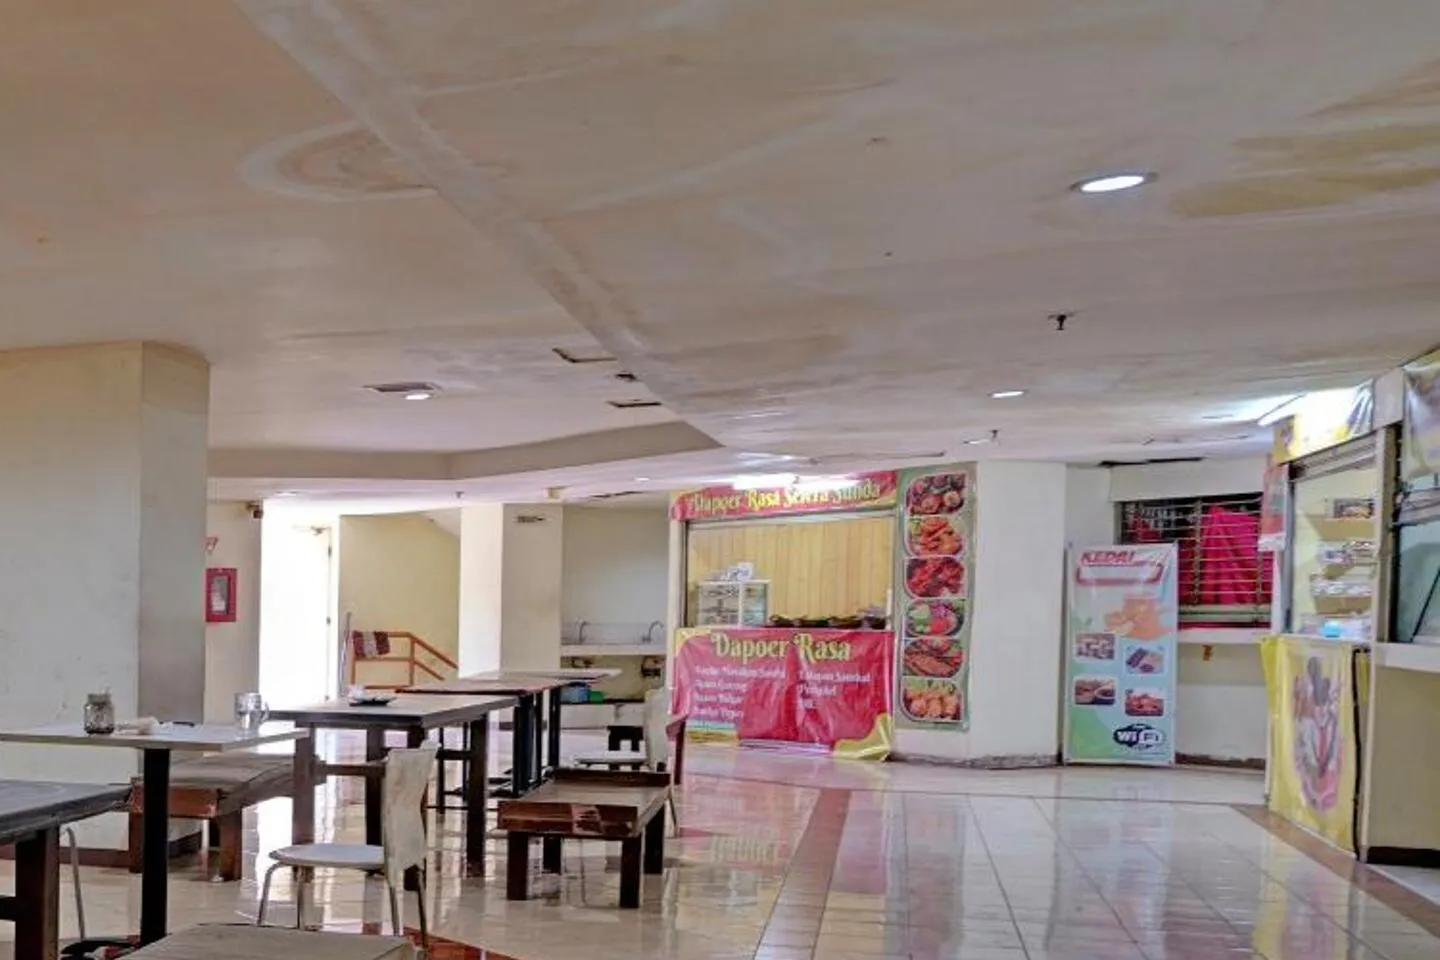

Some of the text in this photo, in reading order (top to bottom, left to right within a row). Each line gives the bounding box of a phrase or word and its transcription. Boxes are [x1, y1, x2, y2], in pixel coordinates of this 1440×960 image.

[691, 492, 741, 515] Dapoer
[746, 487, 781, 511] Rasa
[1081, 550, 1136, 565] KEDAI
[710, 632, 852, 665] Dapoer Rasa
